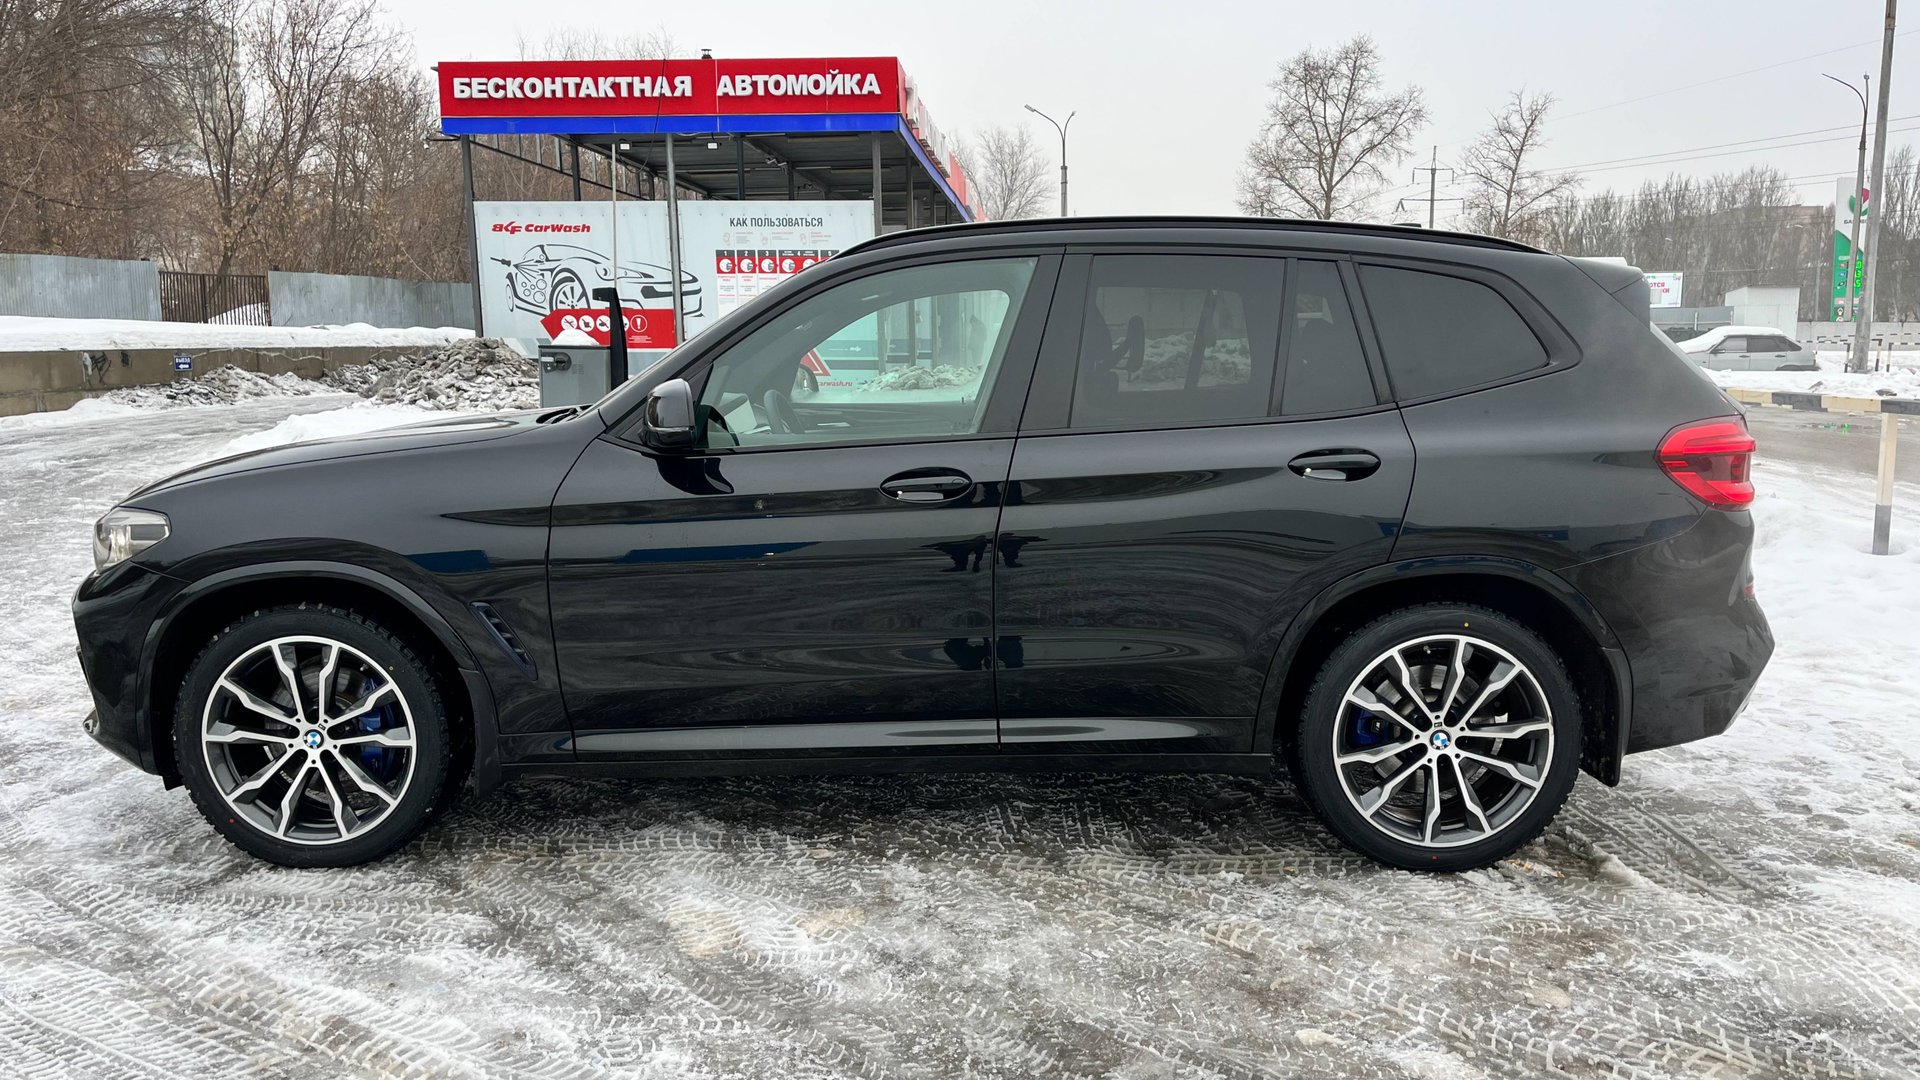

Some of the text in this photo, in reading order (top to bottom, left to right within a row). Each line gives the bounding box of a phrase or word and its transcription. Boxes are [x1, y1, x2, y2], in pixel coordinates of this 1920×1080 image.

[453, 69, 881, 99] БЕСКОНТАКТНАЯ АВТОМОЙКА
[524, 223, 591, 233] CarWash
[729, 217, 823, 228] КАК ПОЛЬЗОВАТЬСЯ
